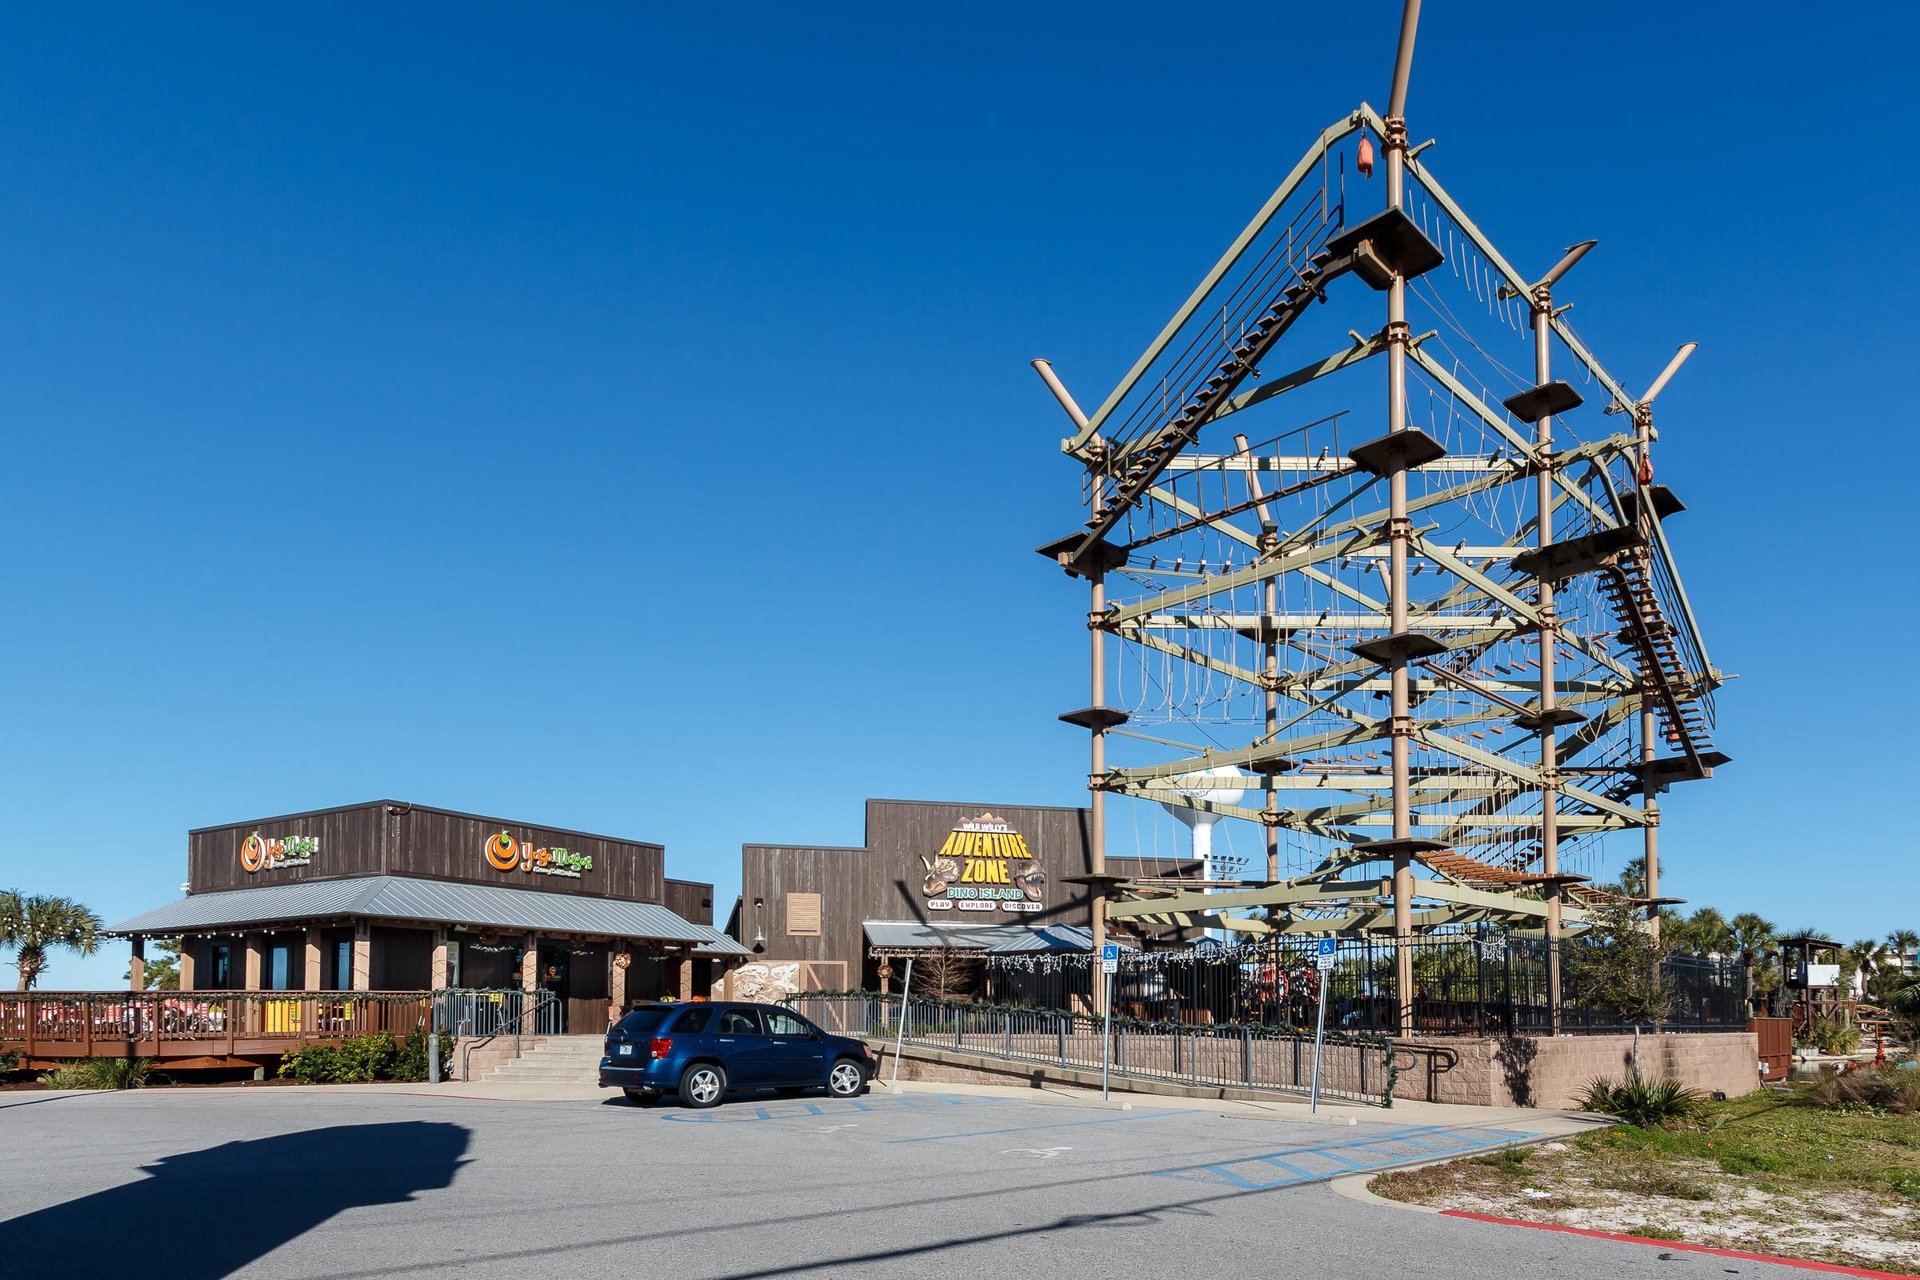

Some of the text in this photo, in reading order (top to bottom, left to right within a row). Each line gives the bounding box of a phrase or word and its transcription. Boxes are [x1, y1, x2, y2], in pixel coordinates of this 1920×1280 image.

[962, 821, 980, 831] WILD
[938, 831, 1032, 858] ADVENTURE
[961, 859, 1011, 884] ZONE
[947, 887, 1024, 900] DINO ISLAND
[960, 901, 993, 909] EXPLORE
[1004, 902, 1040, 910] DISCOVER
